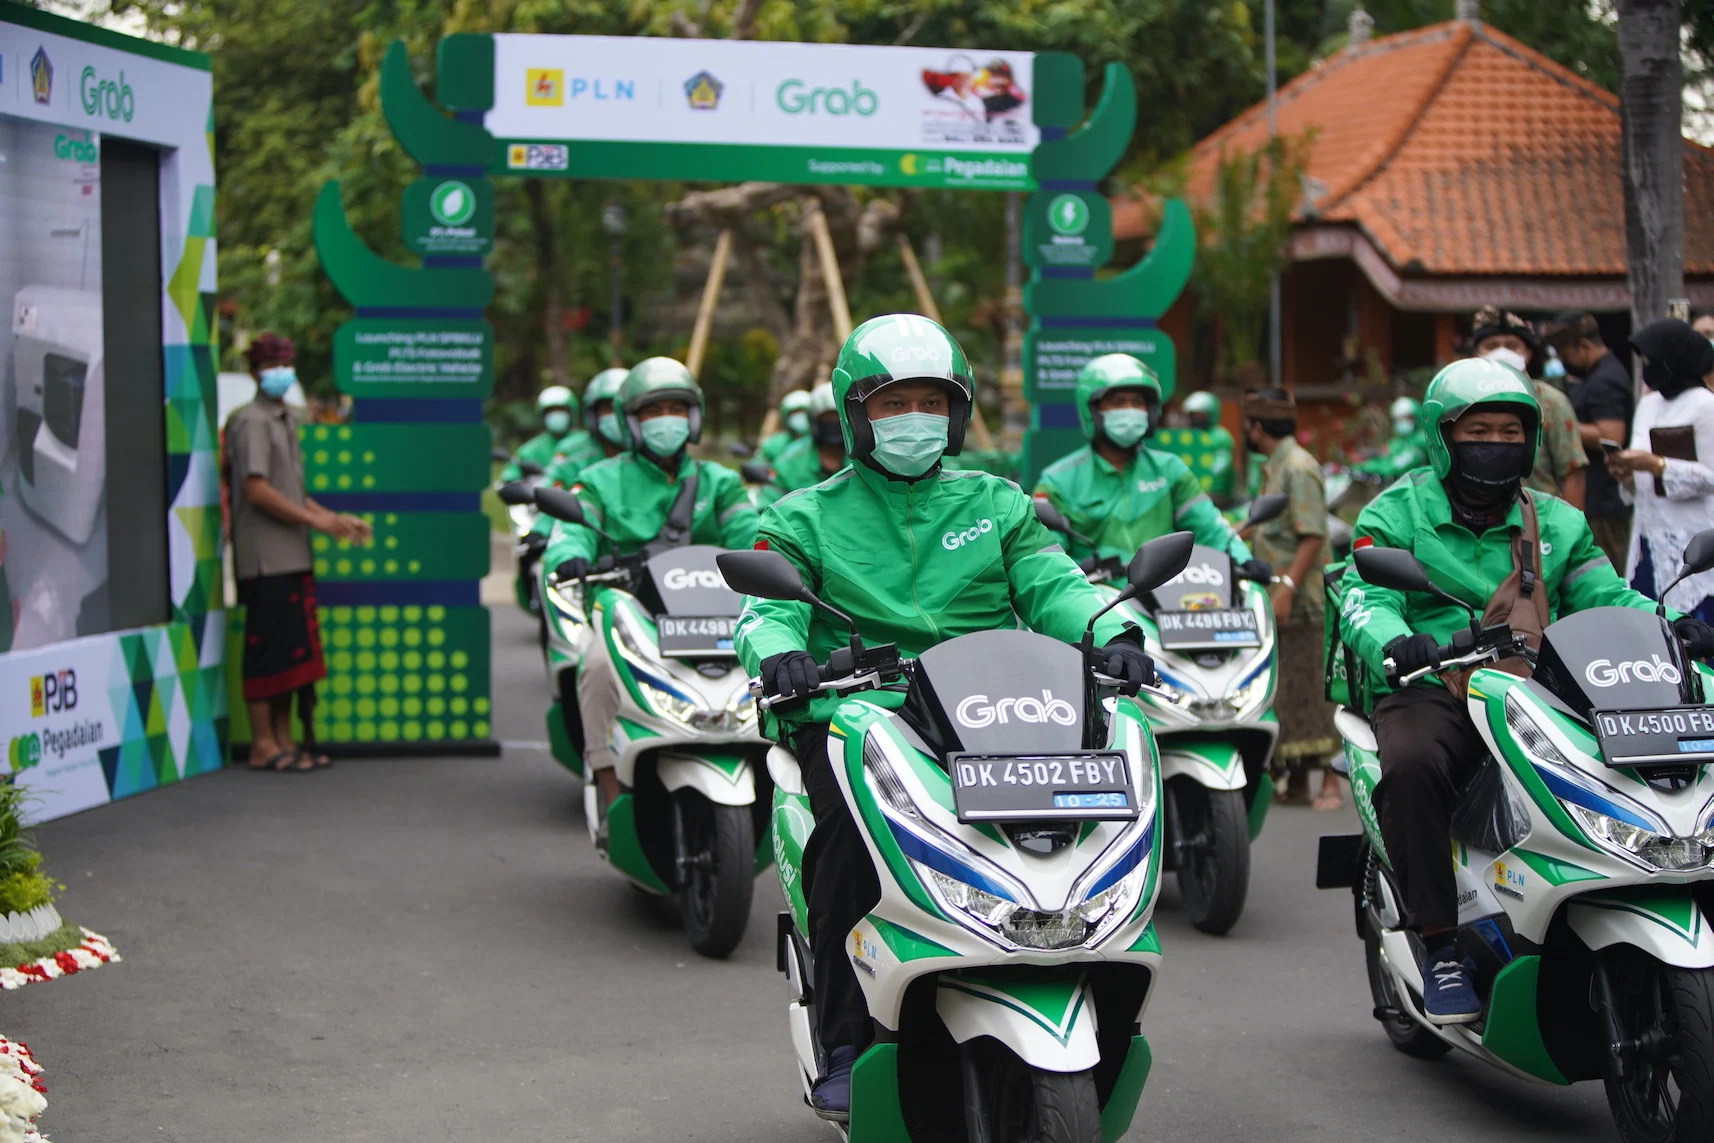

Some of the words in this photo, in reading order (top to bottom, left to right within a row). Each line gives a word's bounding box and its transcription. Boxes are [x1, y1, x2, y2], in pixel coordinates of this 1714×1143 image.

[80, 66, 134, 122] Grab
[570, 78, 635, 99] PLN
[776, 78, 879, 117] Grab
[54, 131, 97, 164] Grab
[944, 156, 1028, 178] Pegadaian
[891, 344, 940, 362] Grab
[942, 518, 992, 550] Grab
[663, 567, 735, 590] Gra
[664, 620, 688, 636] DK
[688, 620, 728, 636] 4498
[1162, 614, 1184, 630] DK
[1585, 654, 1682, 687] Grab
[44, 668, 77, 715] PJB
[956, 689, 1077, 728] Grab
[1603, 716, 1636, 736] DK
[1638, 715, 1687, 735] 4500
[1688, 713, 1714, 732] FB
[43, 720, 102, 758] Pegadaian
[960, 763, 998, 786] DK
[1003, 761, 1067, 786] 4502
[1069, 760, 1116, 785] FBY
[1507, 869, 1525, 887] PLN
[863, 939, 877, 960] PLN
